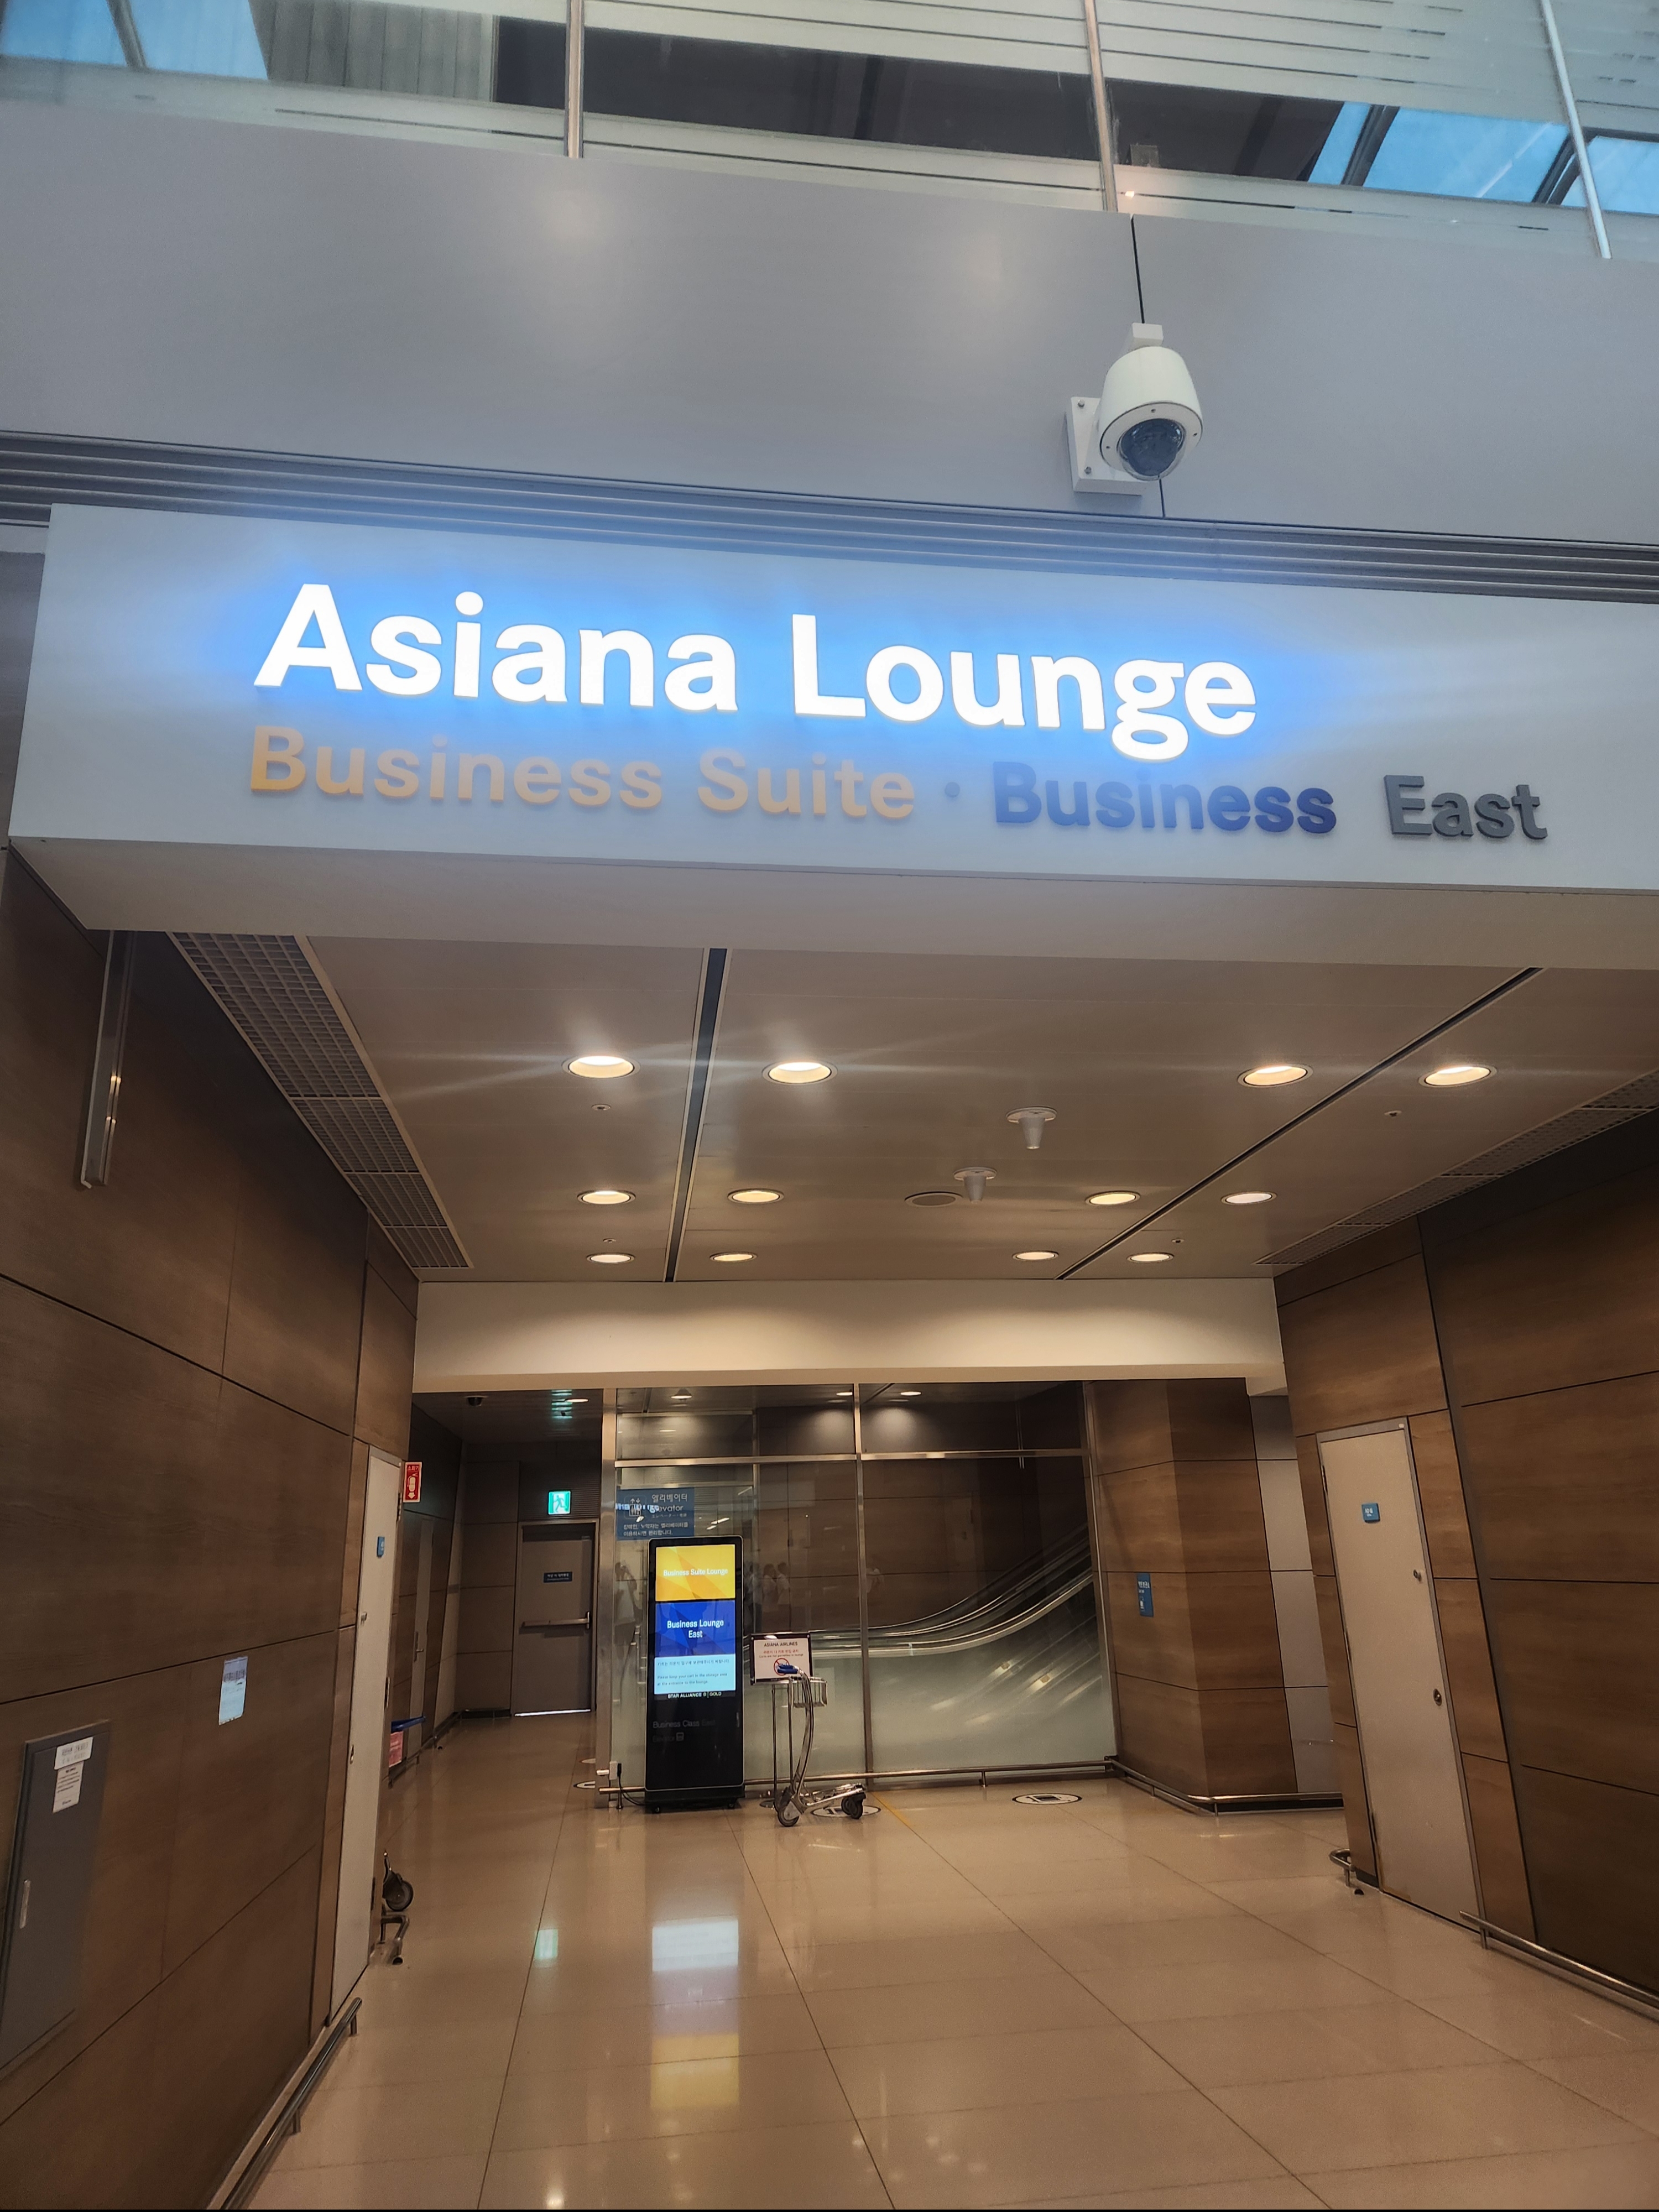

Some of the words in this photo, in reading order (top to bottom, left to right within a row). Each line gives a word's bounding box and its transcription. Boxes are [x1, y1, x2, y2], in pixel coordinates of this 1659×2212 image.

[254, 583, 738, 712] Asiana
[791, 614, 1257, 761] Lounge
[251, 725, 663, 809] Business
[697, 748, 915, 821] Suite
[992, 761, 1338, 835] Business
[1384, 774, 1548, 841] East
[667, 1620, 697, 1629] Business
[699, 1619, 724, 1628] Lounge
[688, 1630, 703, 1638] East
[653, 1720, 681, 1729] Business
